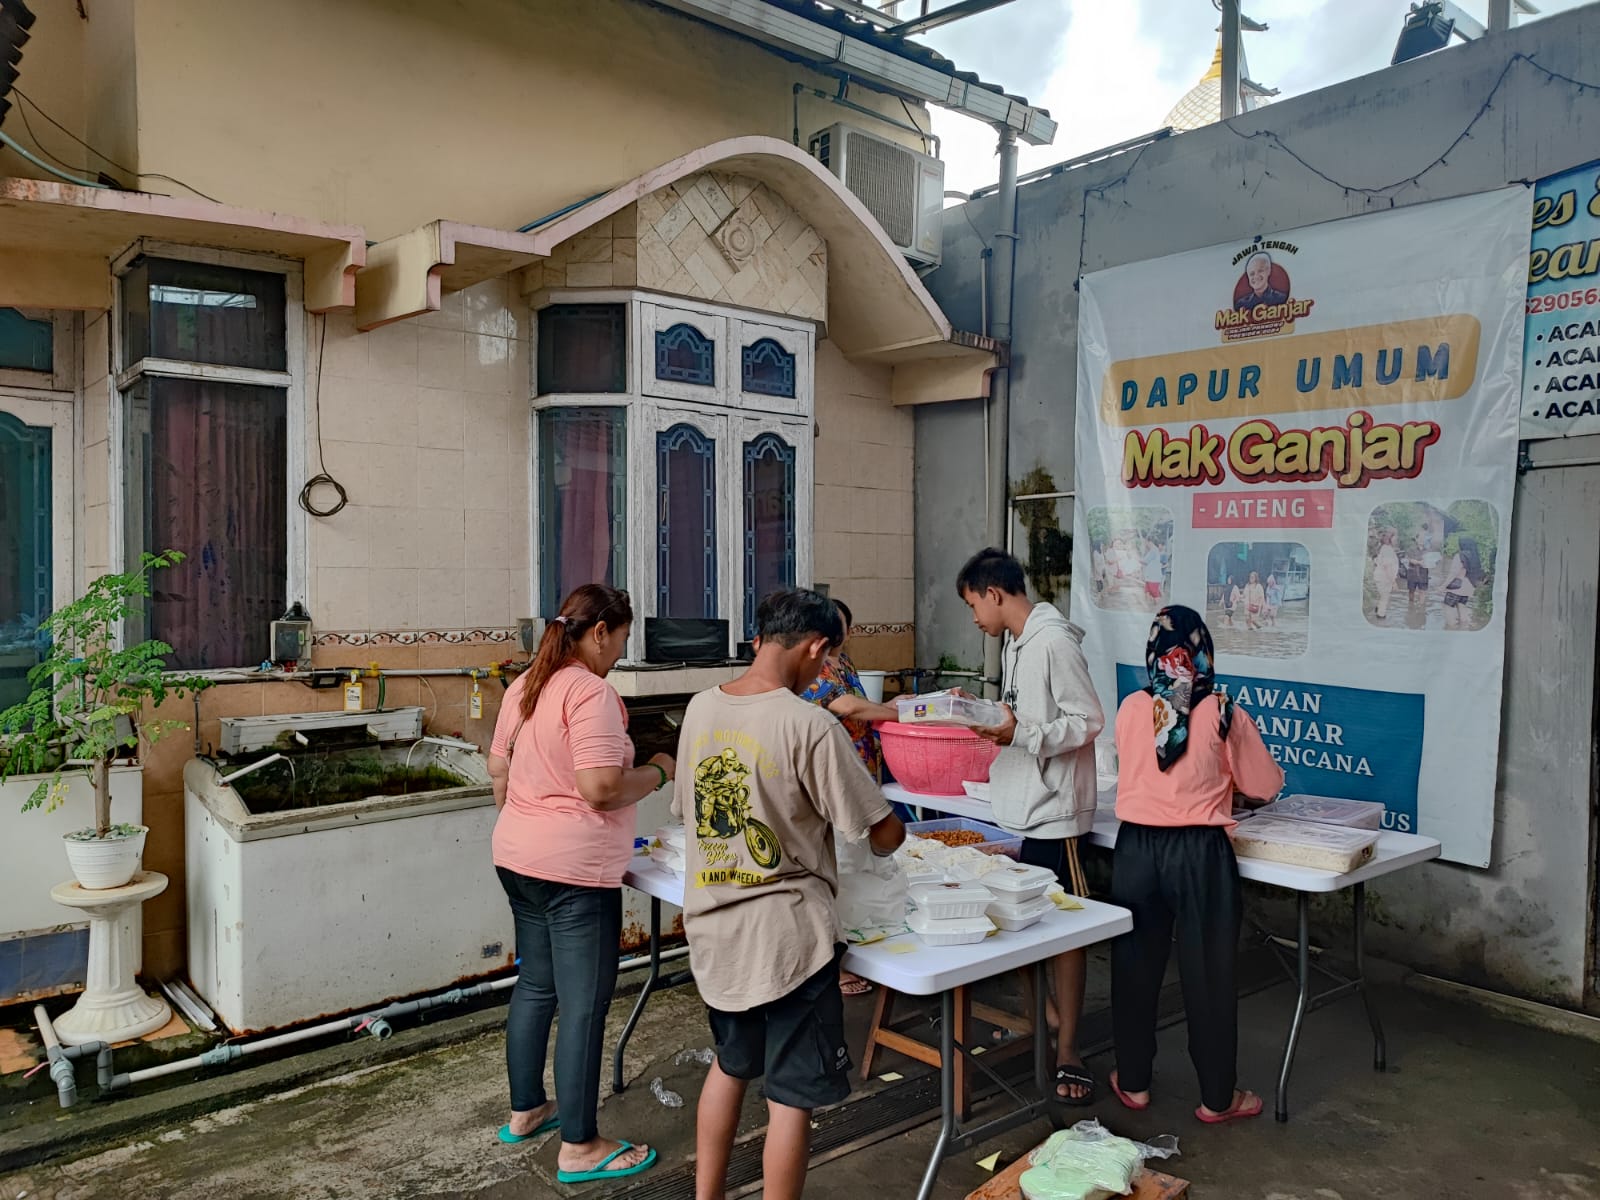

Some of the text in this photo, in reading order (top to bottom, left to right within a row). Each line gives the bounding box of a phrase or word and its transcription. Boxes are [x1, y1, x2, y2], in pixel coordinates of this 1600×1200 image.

[1532, 189, 1576, 230] es
[1232, 240, 1299, 266] JAWA TENGAH
[1215, 298, 1313, 329] Mak Ganjar
[1525, 288, 1600, 315] 29056
[1547, 320, 1600, 343] ACA
[1546, 346, 1600, 368] ACA
[1121, 342, 1450, 411] DAPUR UMUM
[1545, 373, 1600, 394] ACA
[1545, 399, 1600, 419] ACA
[1123, 411, 1439, 487] Mak Ganjar
[1214, 498, 1306, 519] JATENG
[1255, 714, 1344, 746] ANJAR
[1268, 744, 1374, 776] ENCANA
[1380, 811, 1410, 831] US
[709, 871, 726, 883] AND
